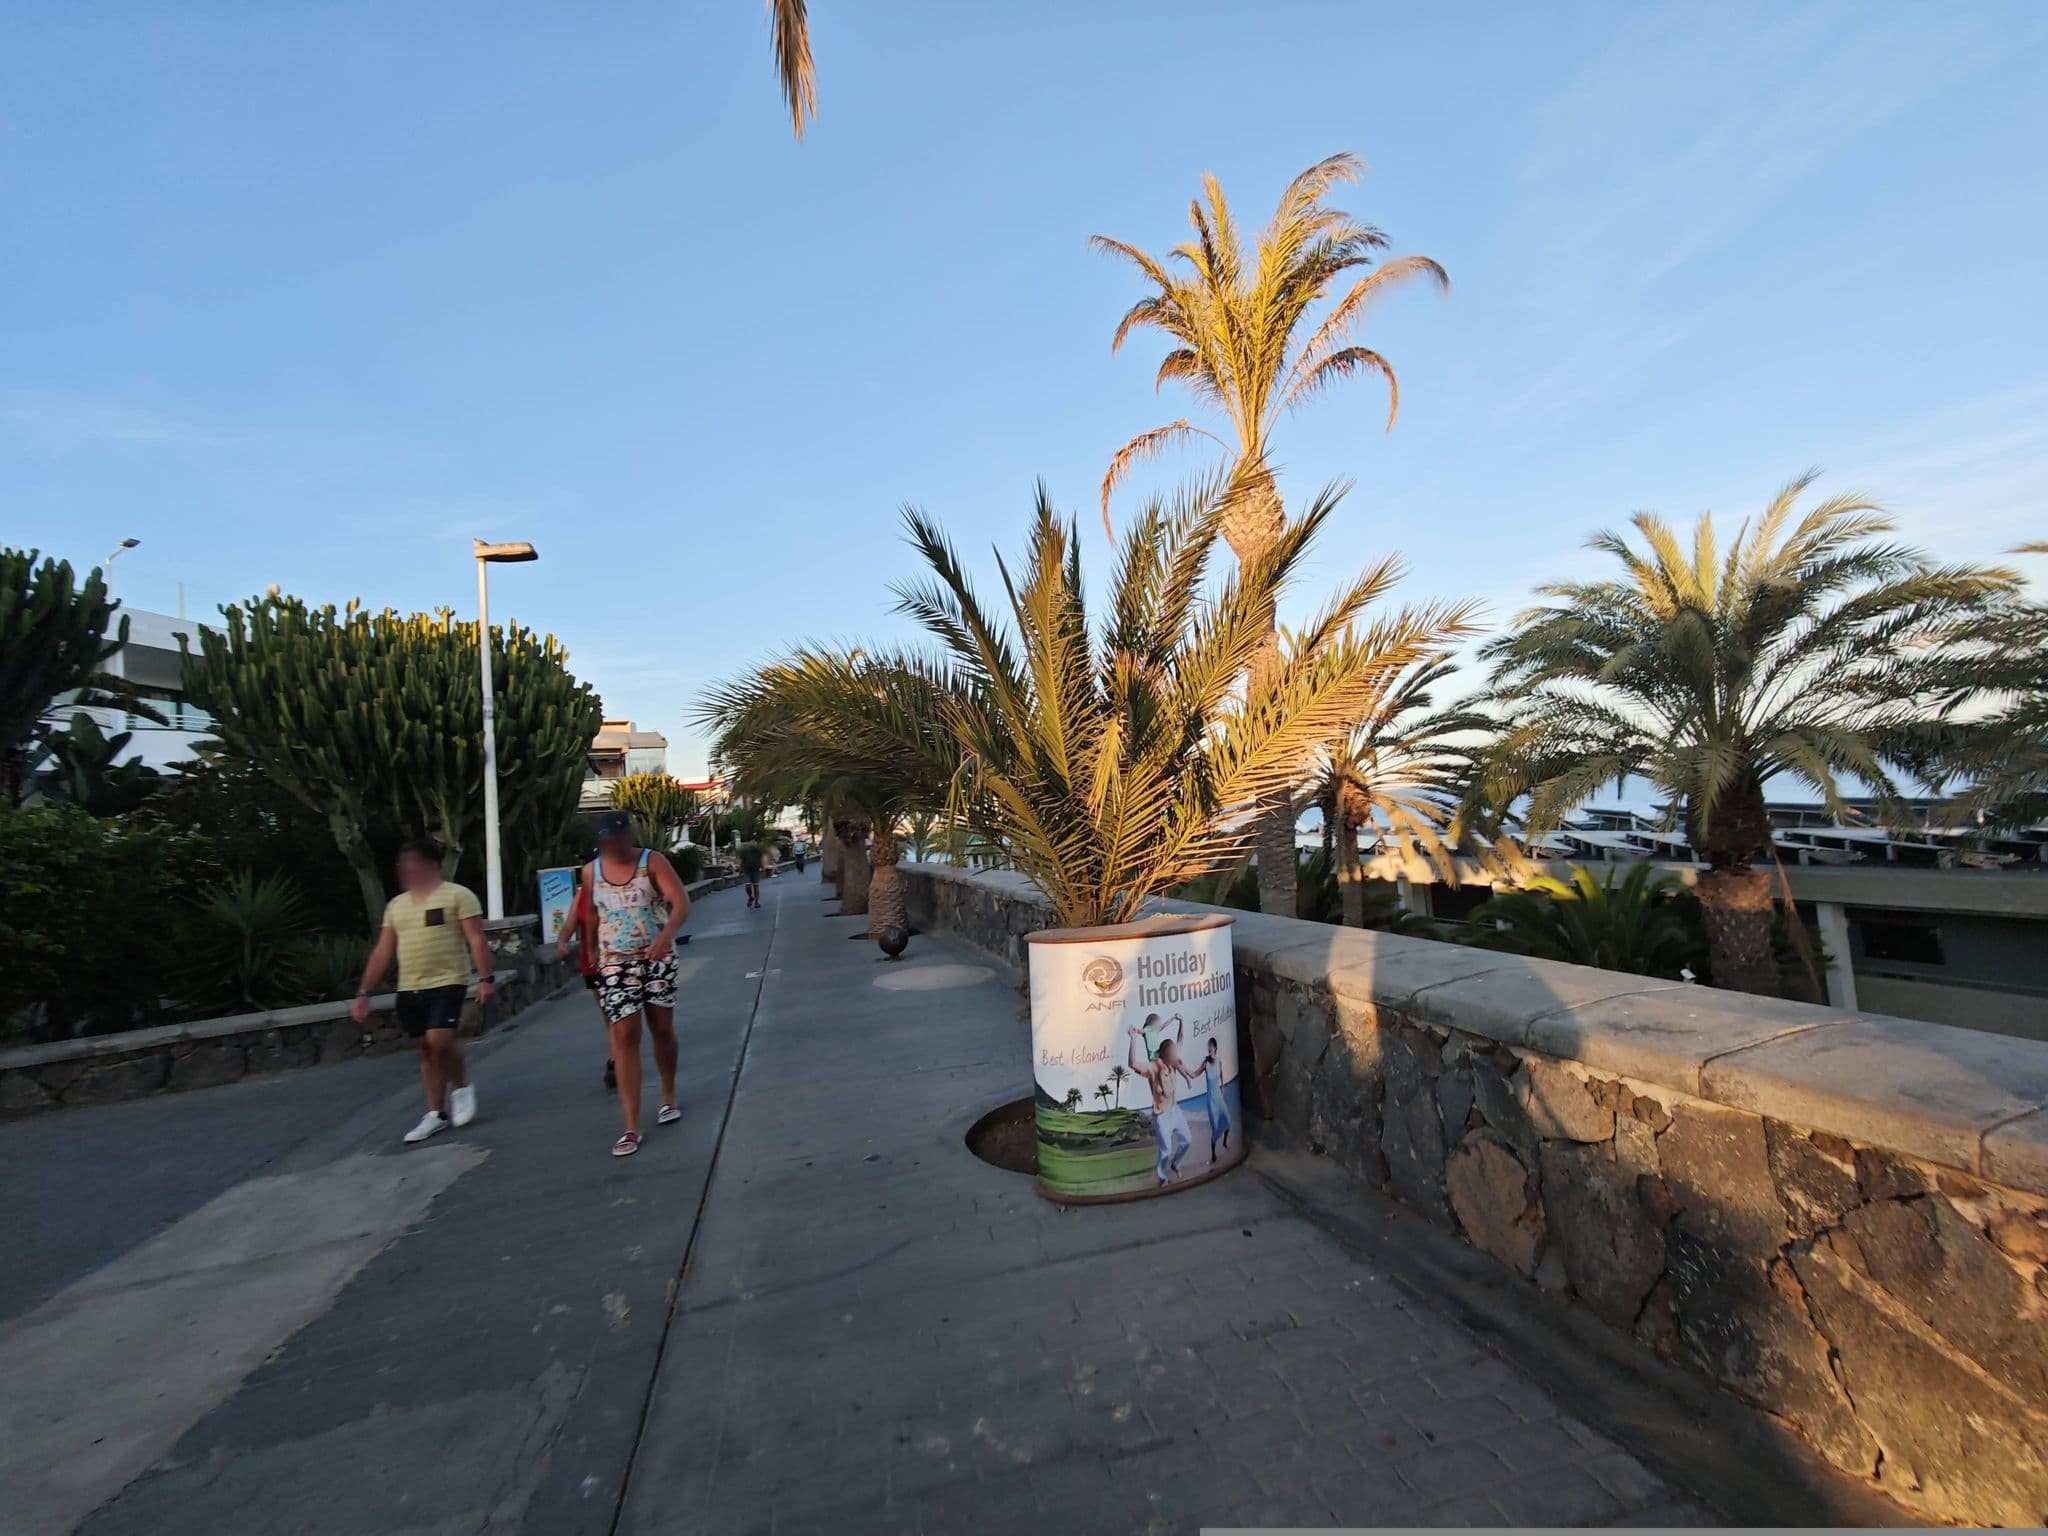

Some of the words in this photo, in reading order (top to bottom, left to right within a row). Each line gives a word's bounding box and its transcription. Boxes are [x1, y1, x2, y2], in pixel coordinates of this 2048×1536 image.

[1137, 952, 1207, 979] Holiday
[1138, 971, 1232, 1007] Information
[1084, 999, 1127, 1012] ANFI
[1192, 1017, 1212, 1038] Best
[1041, 1049, 1064, 1066] Best
